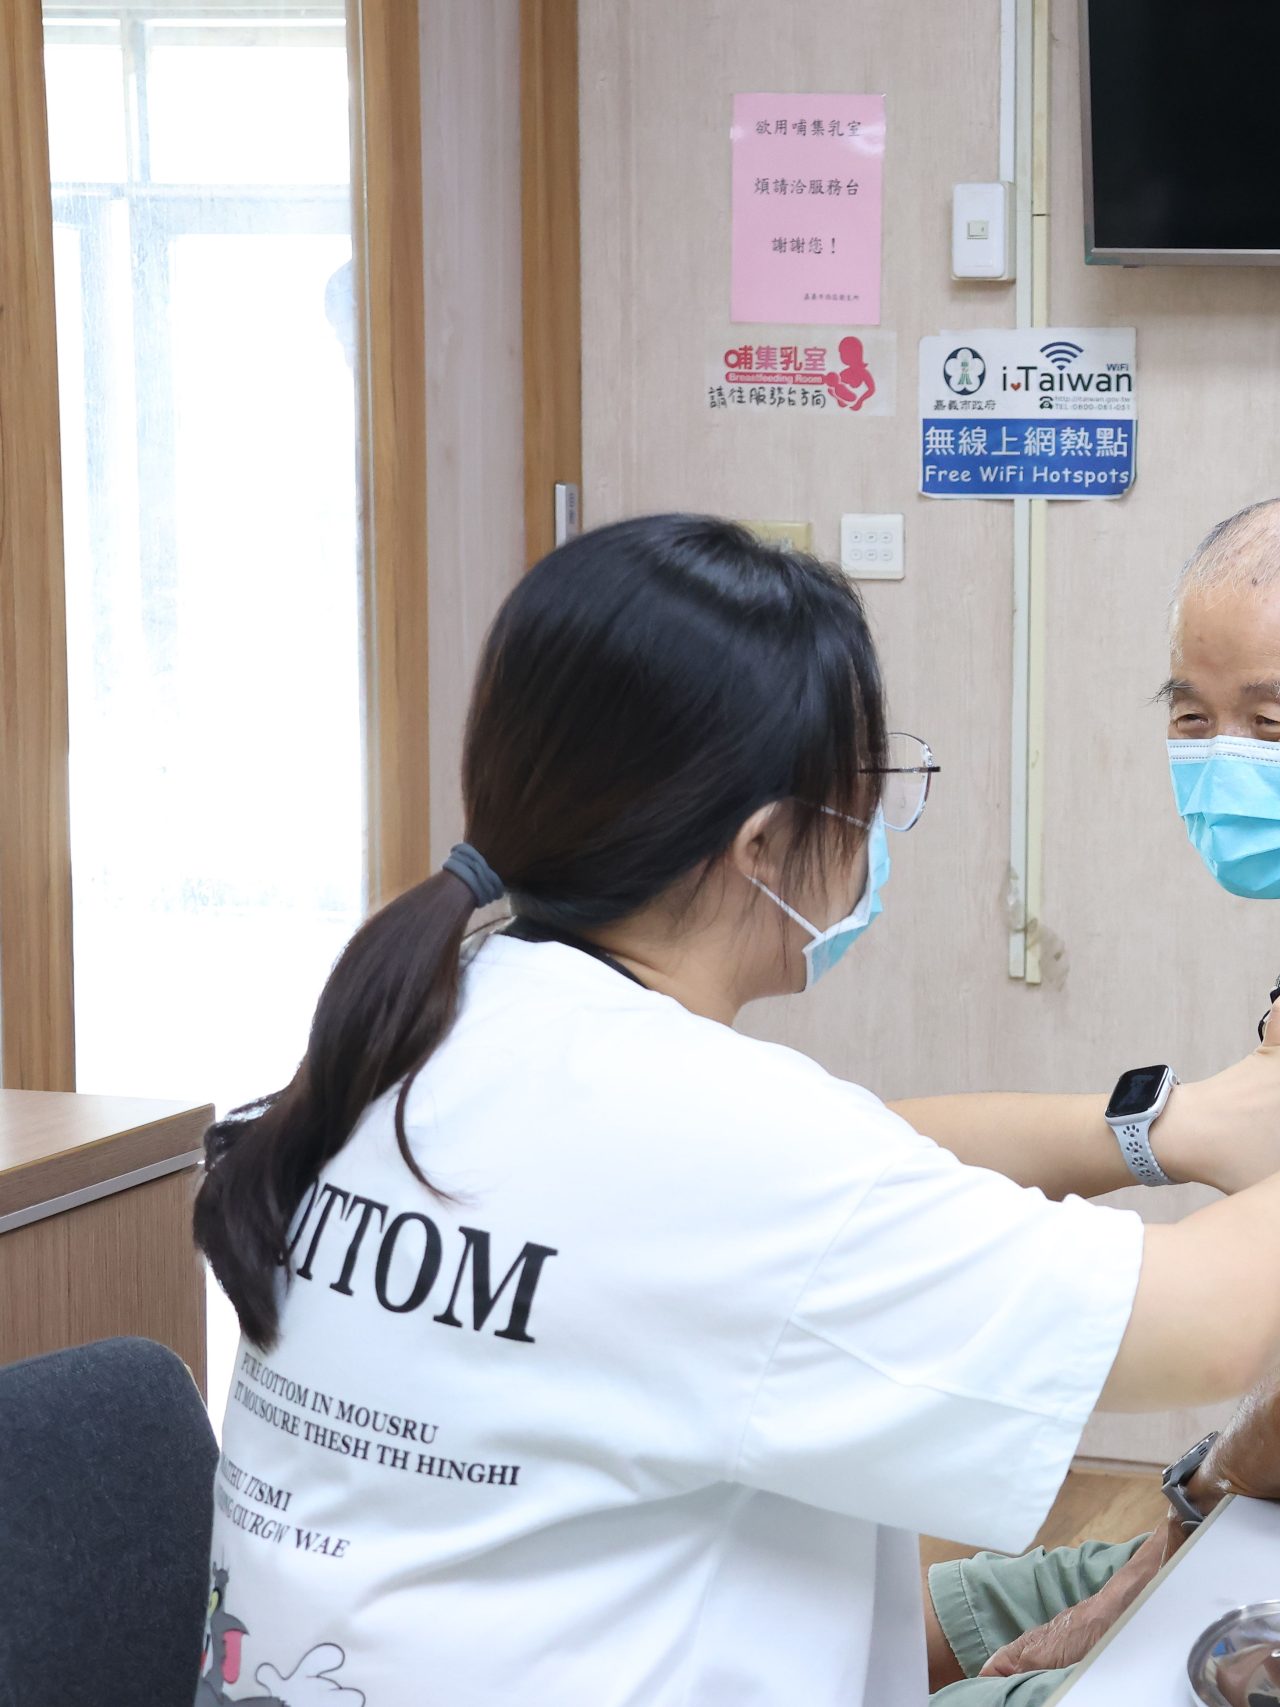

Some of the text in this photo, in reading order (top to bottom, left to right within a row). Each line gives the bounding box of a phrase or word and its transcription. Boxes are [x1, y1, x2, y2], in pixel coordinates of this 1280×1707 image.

[755, 119, 862, 137] 欲用哺集乳室
[754, 178, 859, 196] 煩請洽服務台
[724, 345, 827, 371] 哺集乳室
[1106, 363, 1129, 372] WiFi
[795, 375, 823, 384] Room
[925, 426, 1129, 458] 無線上網熱點
[925, 465, 1129, 487] Free WiFi Hotspots
[260, 1366, 309, 1407] COTTOM
[311, 1391, 333, 1416] IN
[334, 1400, 439, 1445] MOUSRU
[304, 1420, 371, 1460] THESH
[377, 1443, 411, 1470] TH
[415, 1452, 521, 1486] HINGHI
[295, 1527, 351, 1558] WAE
